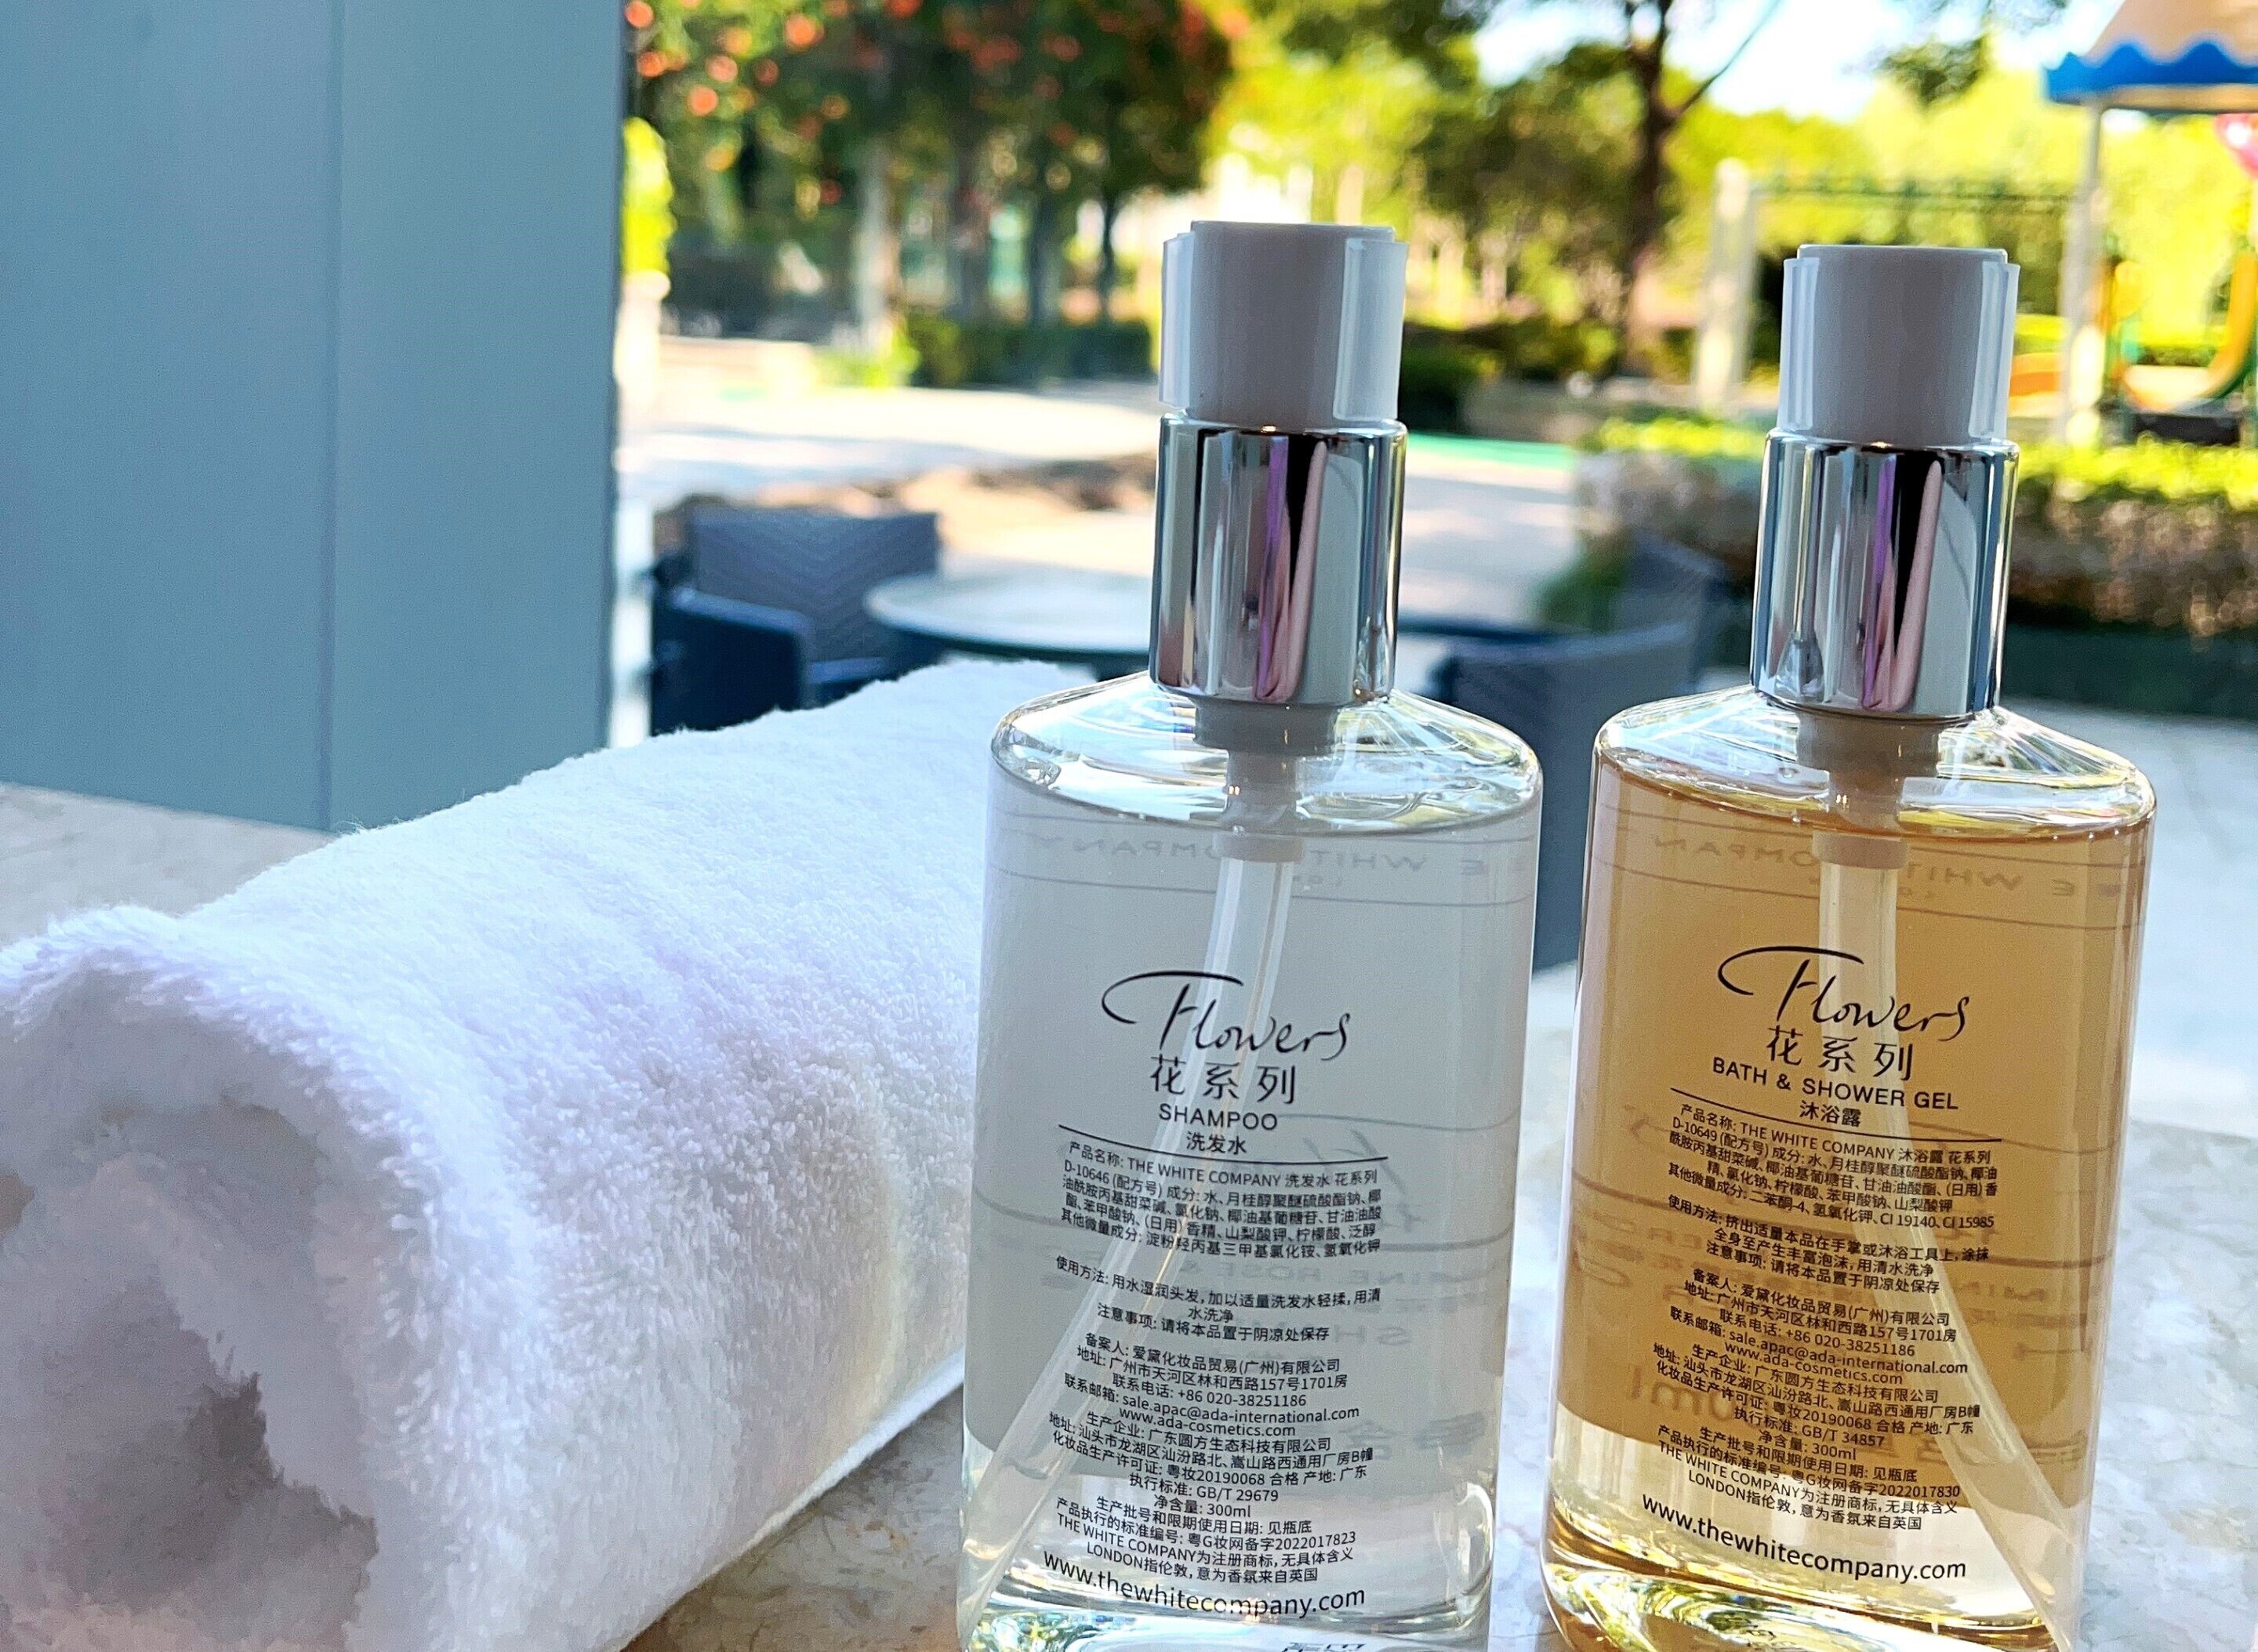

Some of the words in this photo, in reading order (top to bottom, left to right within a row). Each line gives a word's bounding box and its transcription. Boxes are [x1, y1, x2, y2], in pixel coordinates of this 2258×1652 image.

[1717, 945, 1970, 1041] Flowers
[1101, 969, 1352, 1061] Flowers
[1712, 1056, 1767, 1086] BATH
[1776, 1073, 1791, 1091] &
[1802, 1077, 1905, 1107] SHOWER
[1914, 1091, 1959, 1111] GEL
[1158, 1103, 1278, 1131] SHAMPOO
[1799, 1100, 1860, 1127] 沐浴露
[1185, 1131, 1247, 1155] 洗发水
[1672, 1116, 1718, 1142] D-10649
[1740, 1122, 1767, 1139] THE
[1771, 1130, 1818, 1150] WHITE
[1822, 1139, 1895, 1159] COMPANY
[1898, 1148, 1944, 1164] 沐浴露
[1948, 1149, 1991, 1164] 花系列
[1065, 1159, 1110, 1184] D-10646
[1127, 1157, 1154, 1174] THE
[1158, 1163, 1204, 1182] WHITE
[1208, 1170, 1281, 1187] COMPANY
[1285, 1173, 1330, 1188] 洗发水
[1334, 1168, 1378, 1185] 花系列
[1188, 1305, 1233, 1323] 水洗净
[1729, 1331, 1969, 1374] sale.apac@ada-international.com
[1785, 1329, 1811, 1343] +86
[1814, 1334, 1916, 1356] 020-38251186
[1724, 1342, 1903, 1385] www.ada-cosmetics.com
[1122, 1395, 1360, 1423] sale.apac@ada-international.com
[1178, 1389, 1203, 1403] +86
[1207, 1391, 1307, 1407] 020-38251186
[1119, 1407, 1296, 1436] www.ada-cosmetics.com
[1876, 1419, 1906, 1434] 合格
[1801, 1425, 1837, 1442] GB/T
[1842, 1431, 1885, 1447] 34857
[1658, 1440, 1683, 1461] THE
[1686, 1452, 1727, 1479] WHITE
[1812, 1442, 1857, 1460] 300ml
[1269, 1472, 1299, 1486] 合格
[1196, 1486, 1232, 1501] GB/T
[1236, 1490, 1279, 1501] 29679
[1207, 1503, 1251, 1517] 300ml
[1058, 1512, 1080, 1534] THE
[1083, 1523, 1124, 1548] WHITE
[1642, 1494, 1966, 1584] www.thewhitecompany.com
[1044, 1550, 1365, 1618] www.thewhitecompany.com
